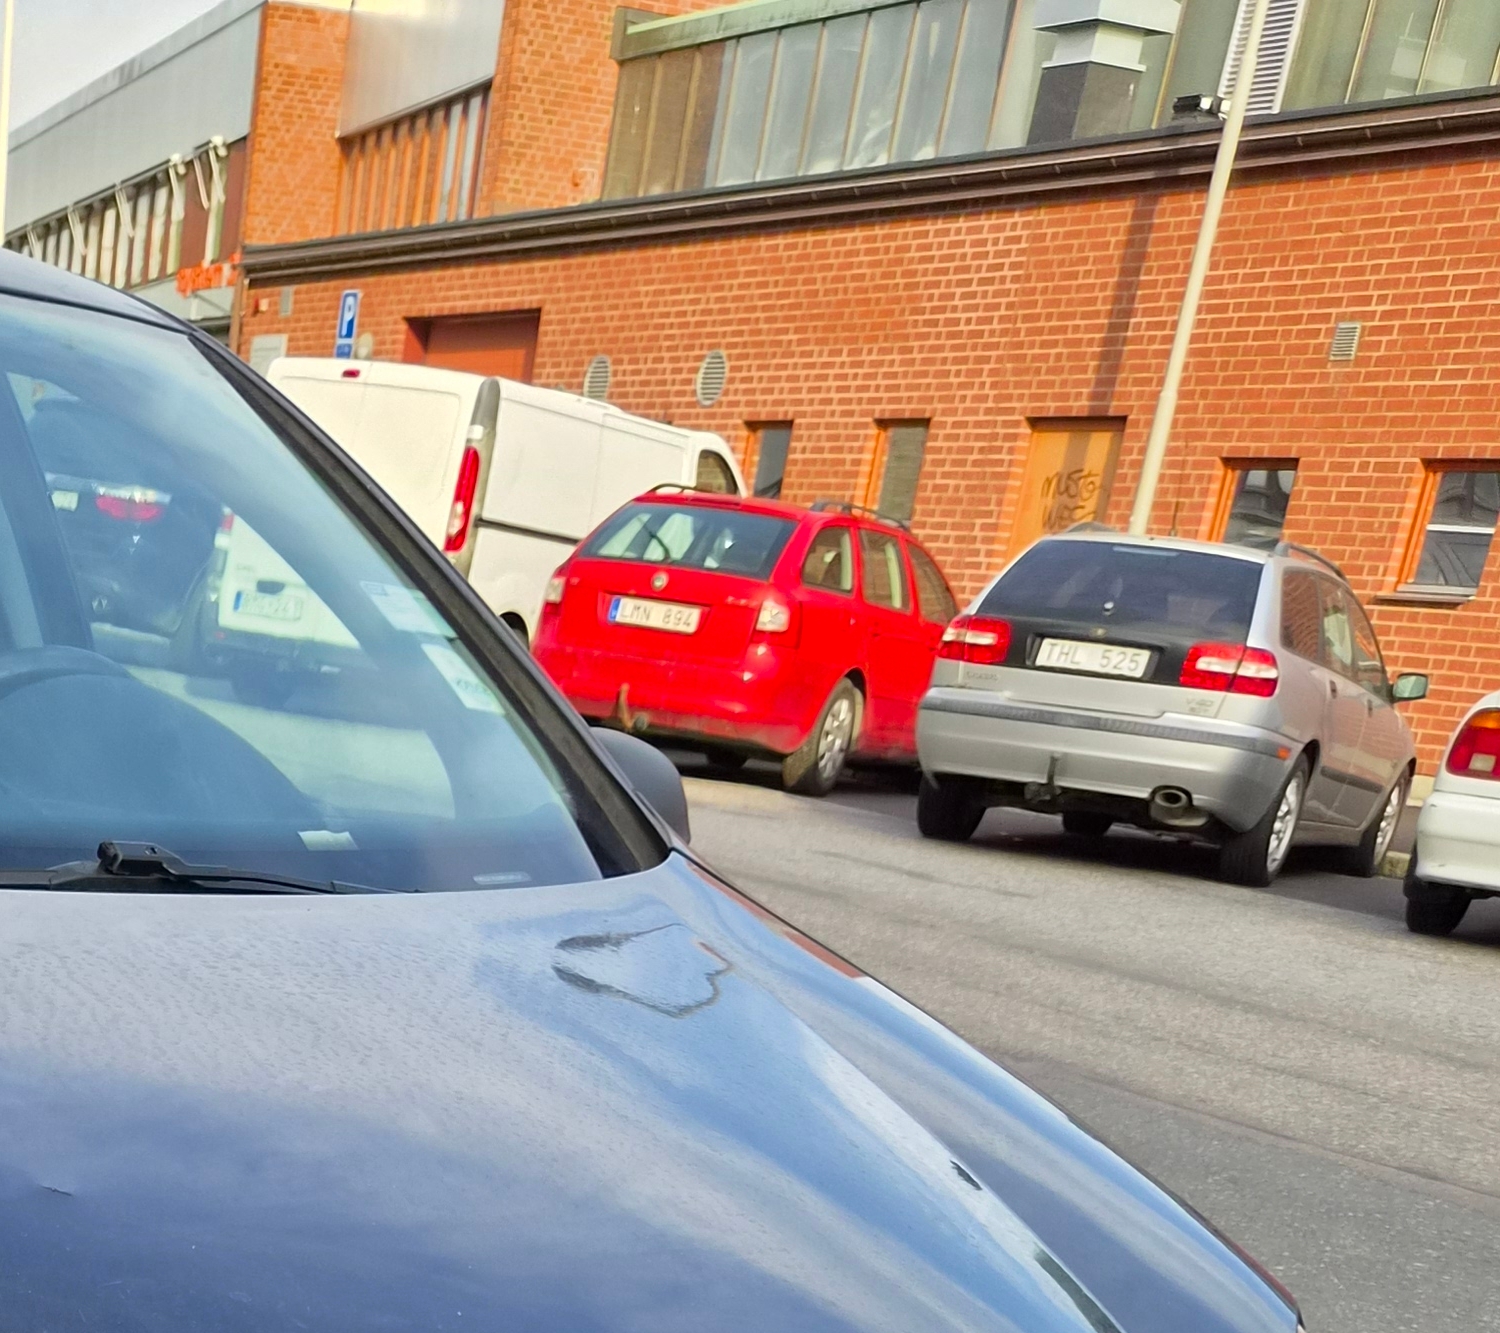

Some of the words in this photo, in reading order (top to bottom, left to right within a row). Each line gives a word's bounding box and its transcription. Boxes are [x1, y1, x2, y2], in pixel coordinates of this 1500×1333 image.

[341, 295, 355, 337] P
[620, 602, 653, 622] LMN
[662, 607, 694, 627] 894
[1046, 642, 1081, 665] THL
[1100, 649, 1141, 672] 525
